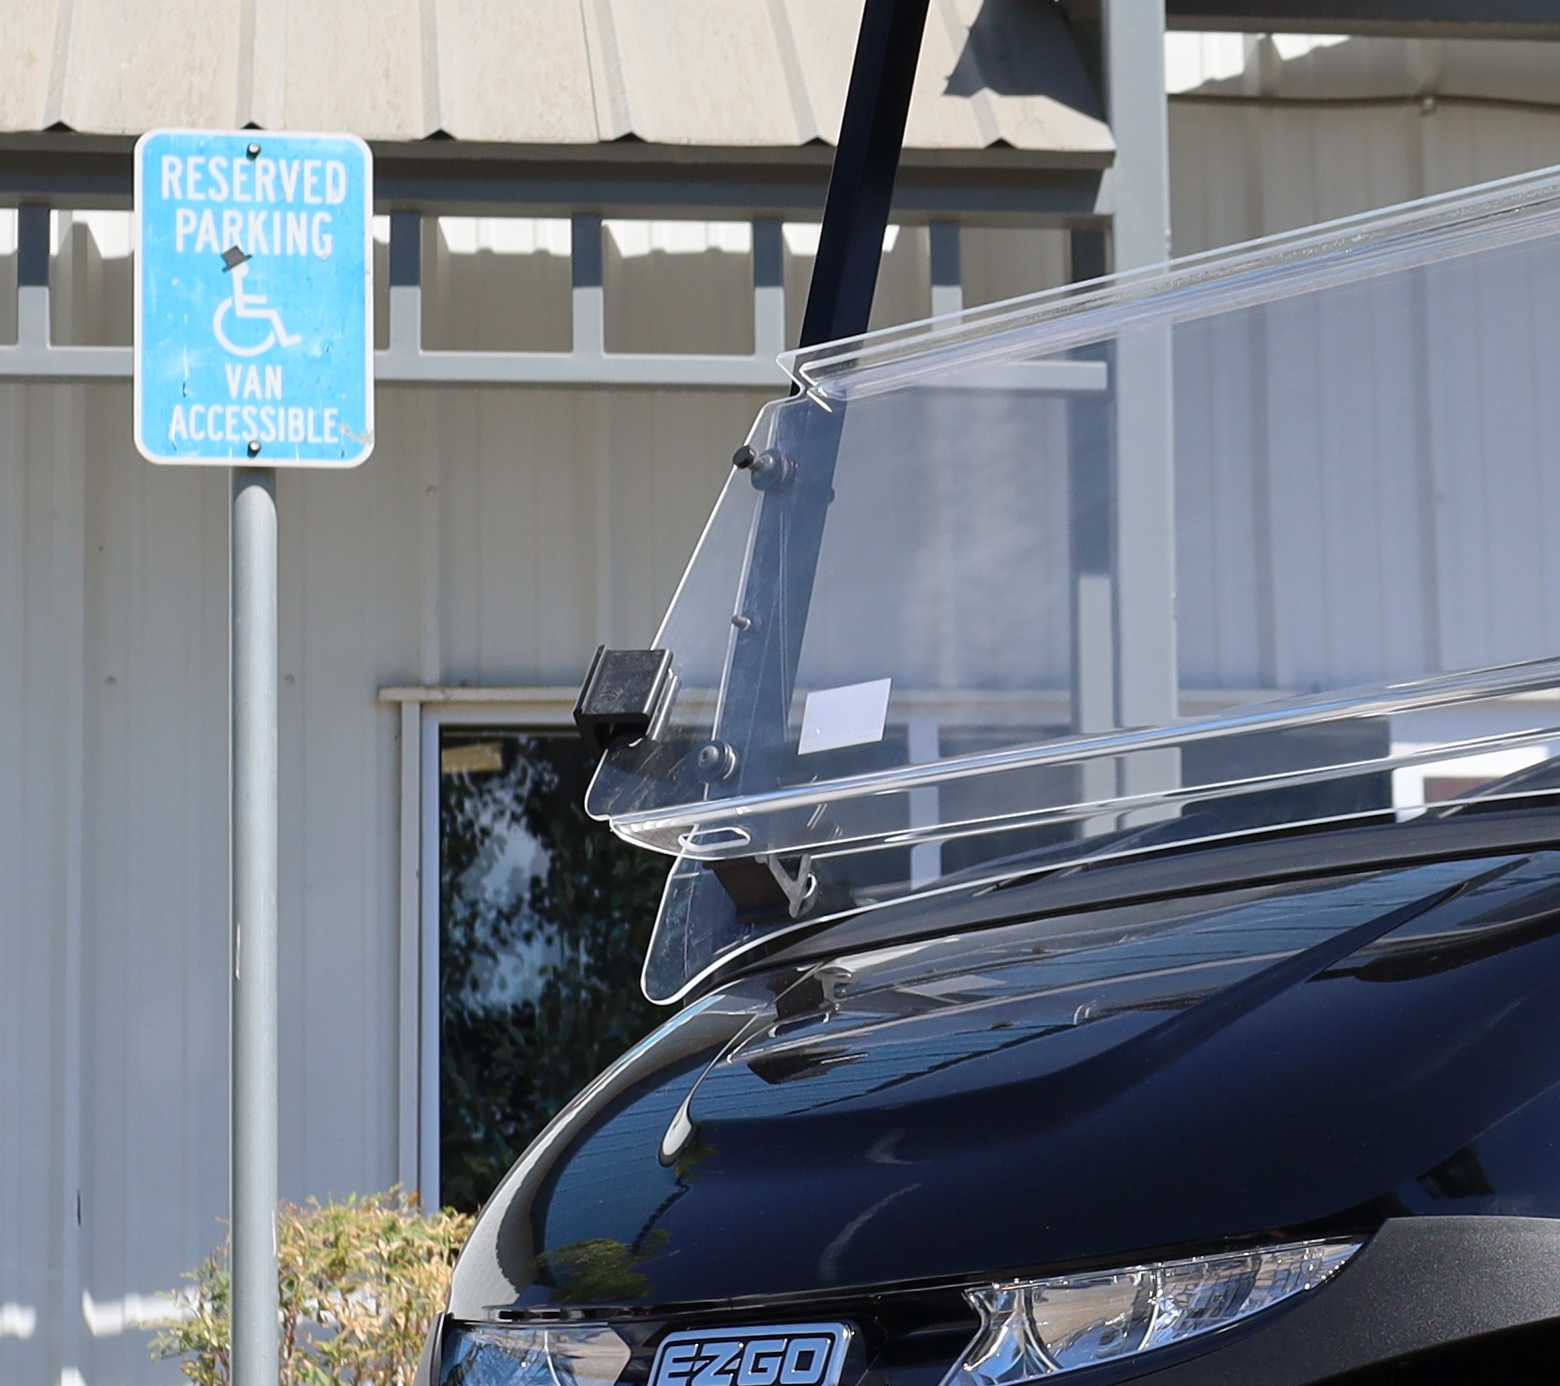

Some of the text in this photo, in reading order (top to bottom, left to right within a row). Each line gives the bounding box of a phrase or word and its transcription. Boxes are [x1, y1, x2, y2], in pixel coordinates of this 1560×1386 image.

[160, 155, 347, 205] RESERVED
[174, 208, 334, 257] PARKING
[225, 363, 283, 401] VAN
[167, 404, 340, 444] ACCESSIBLE
